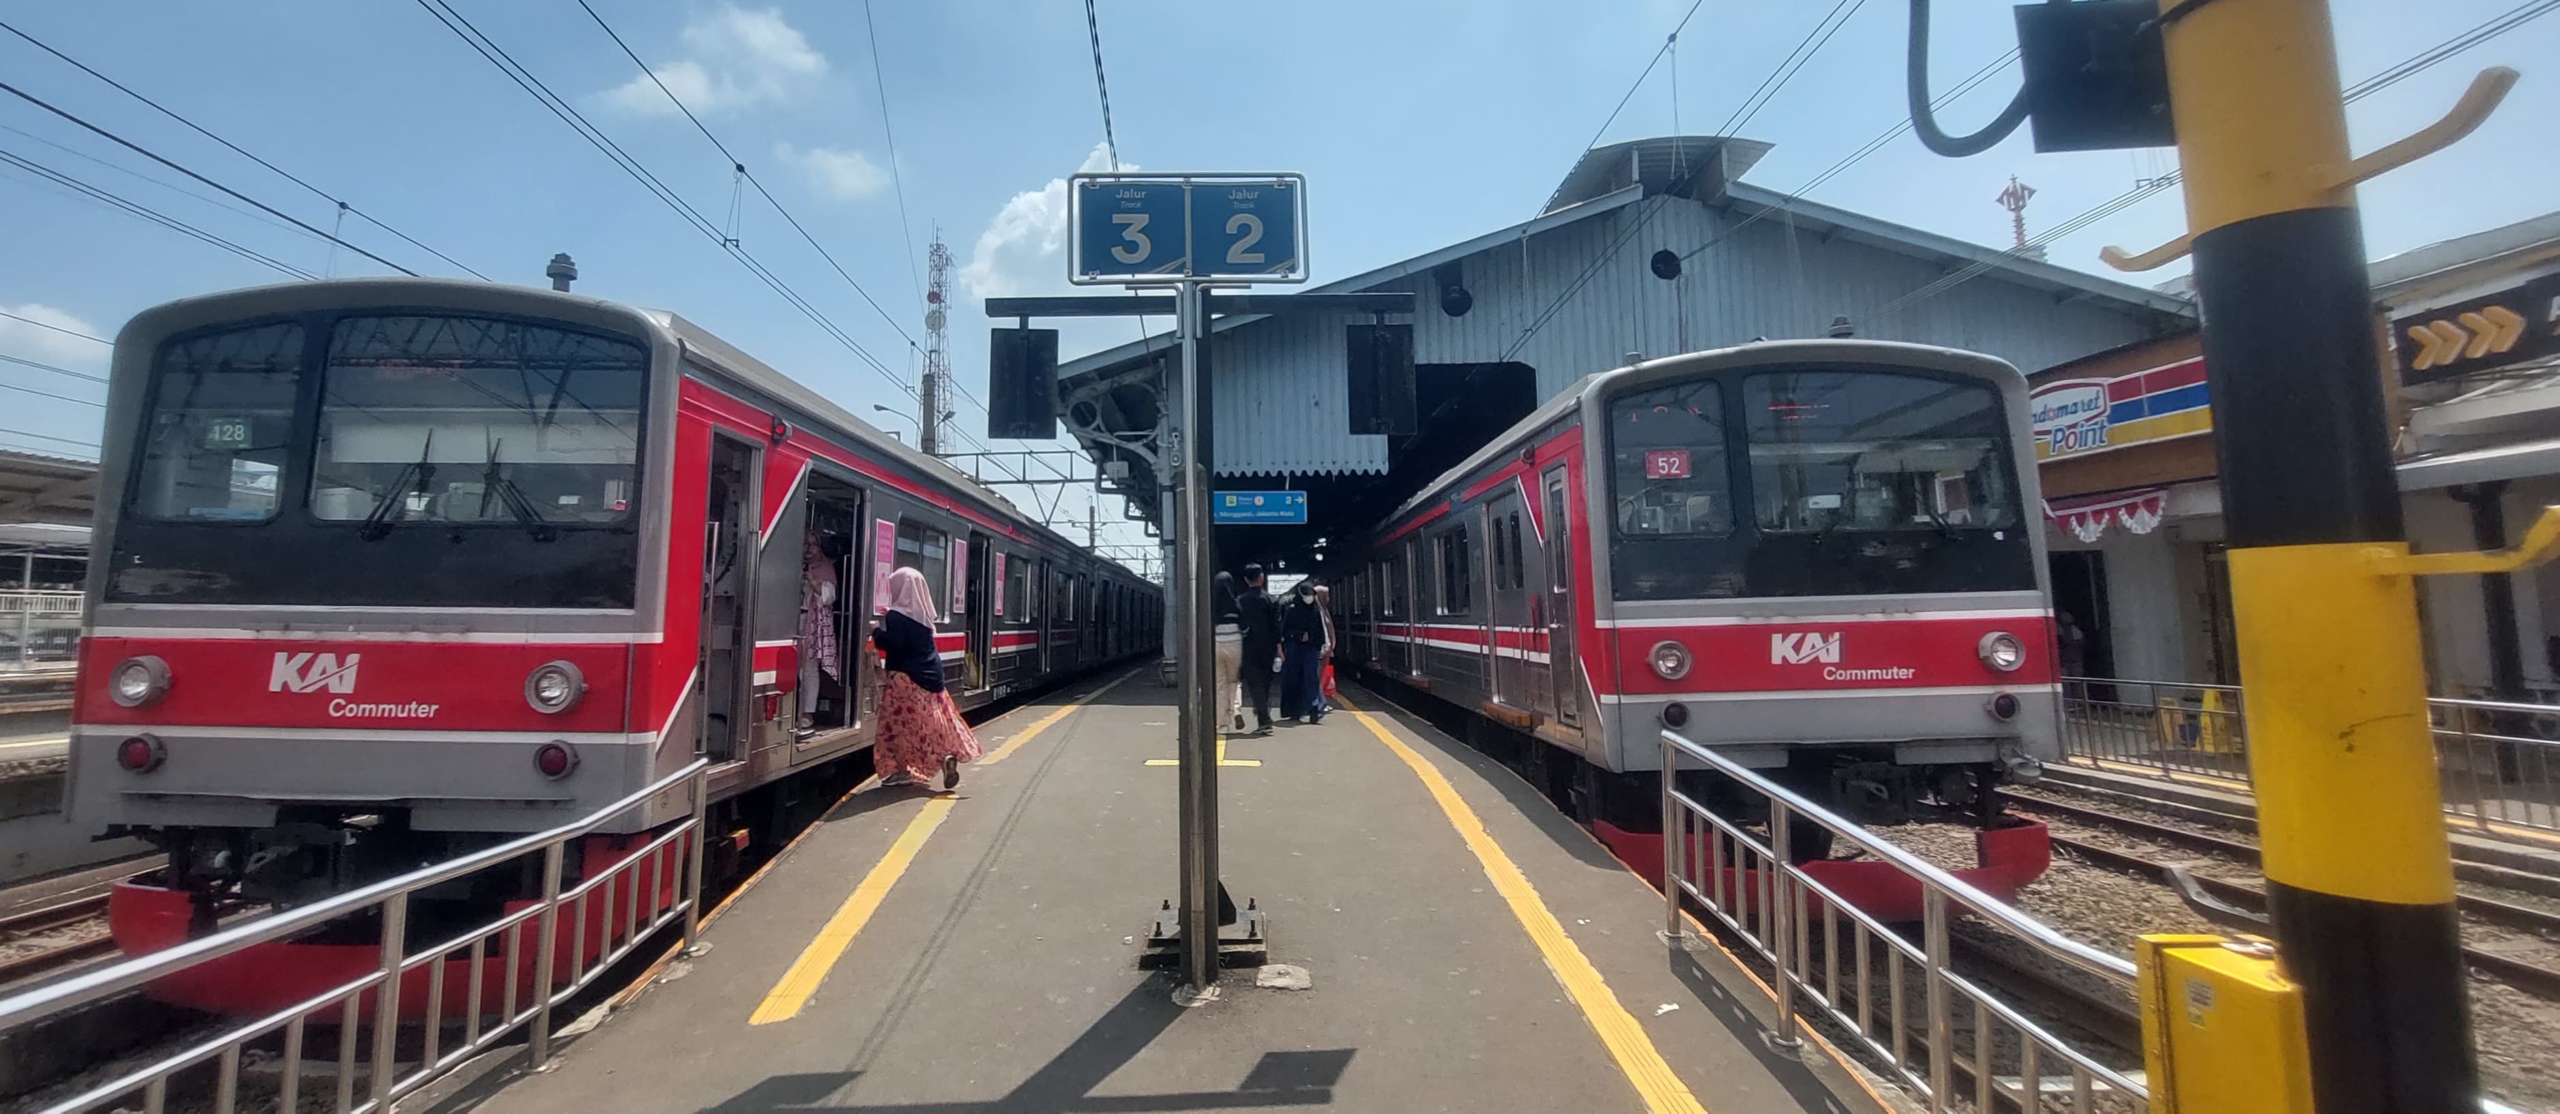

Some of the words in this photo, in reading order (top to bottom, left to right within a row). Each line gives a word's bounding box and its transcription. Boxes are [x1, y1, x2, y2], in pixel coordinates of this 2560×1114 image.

[1115, 188, 1147, 199] Jalur
[1228, 189, 1260, 200] Jalur
[1120, 201, 1142, 209] Track
[1233, 201, 1255, 209] Track
[1111, 213, 1151, 264] 3
[1225, 213, 1265, 263] 2
[2031, 389, 2102, 424] ndomaret
[2050, 418, 2108, 456] Point
[1657, 457, 1681, 475] 52
[1771, 631, 1841, 665] KAI
[269, 651, 361, 694] KAI
[1823, 666, 1916, 681] Commuter
[328, 698, 439, 718] Commuter
